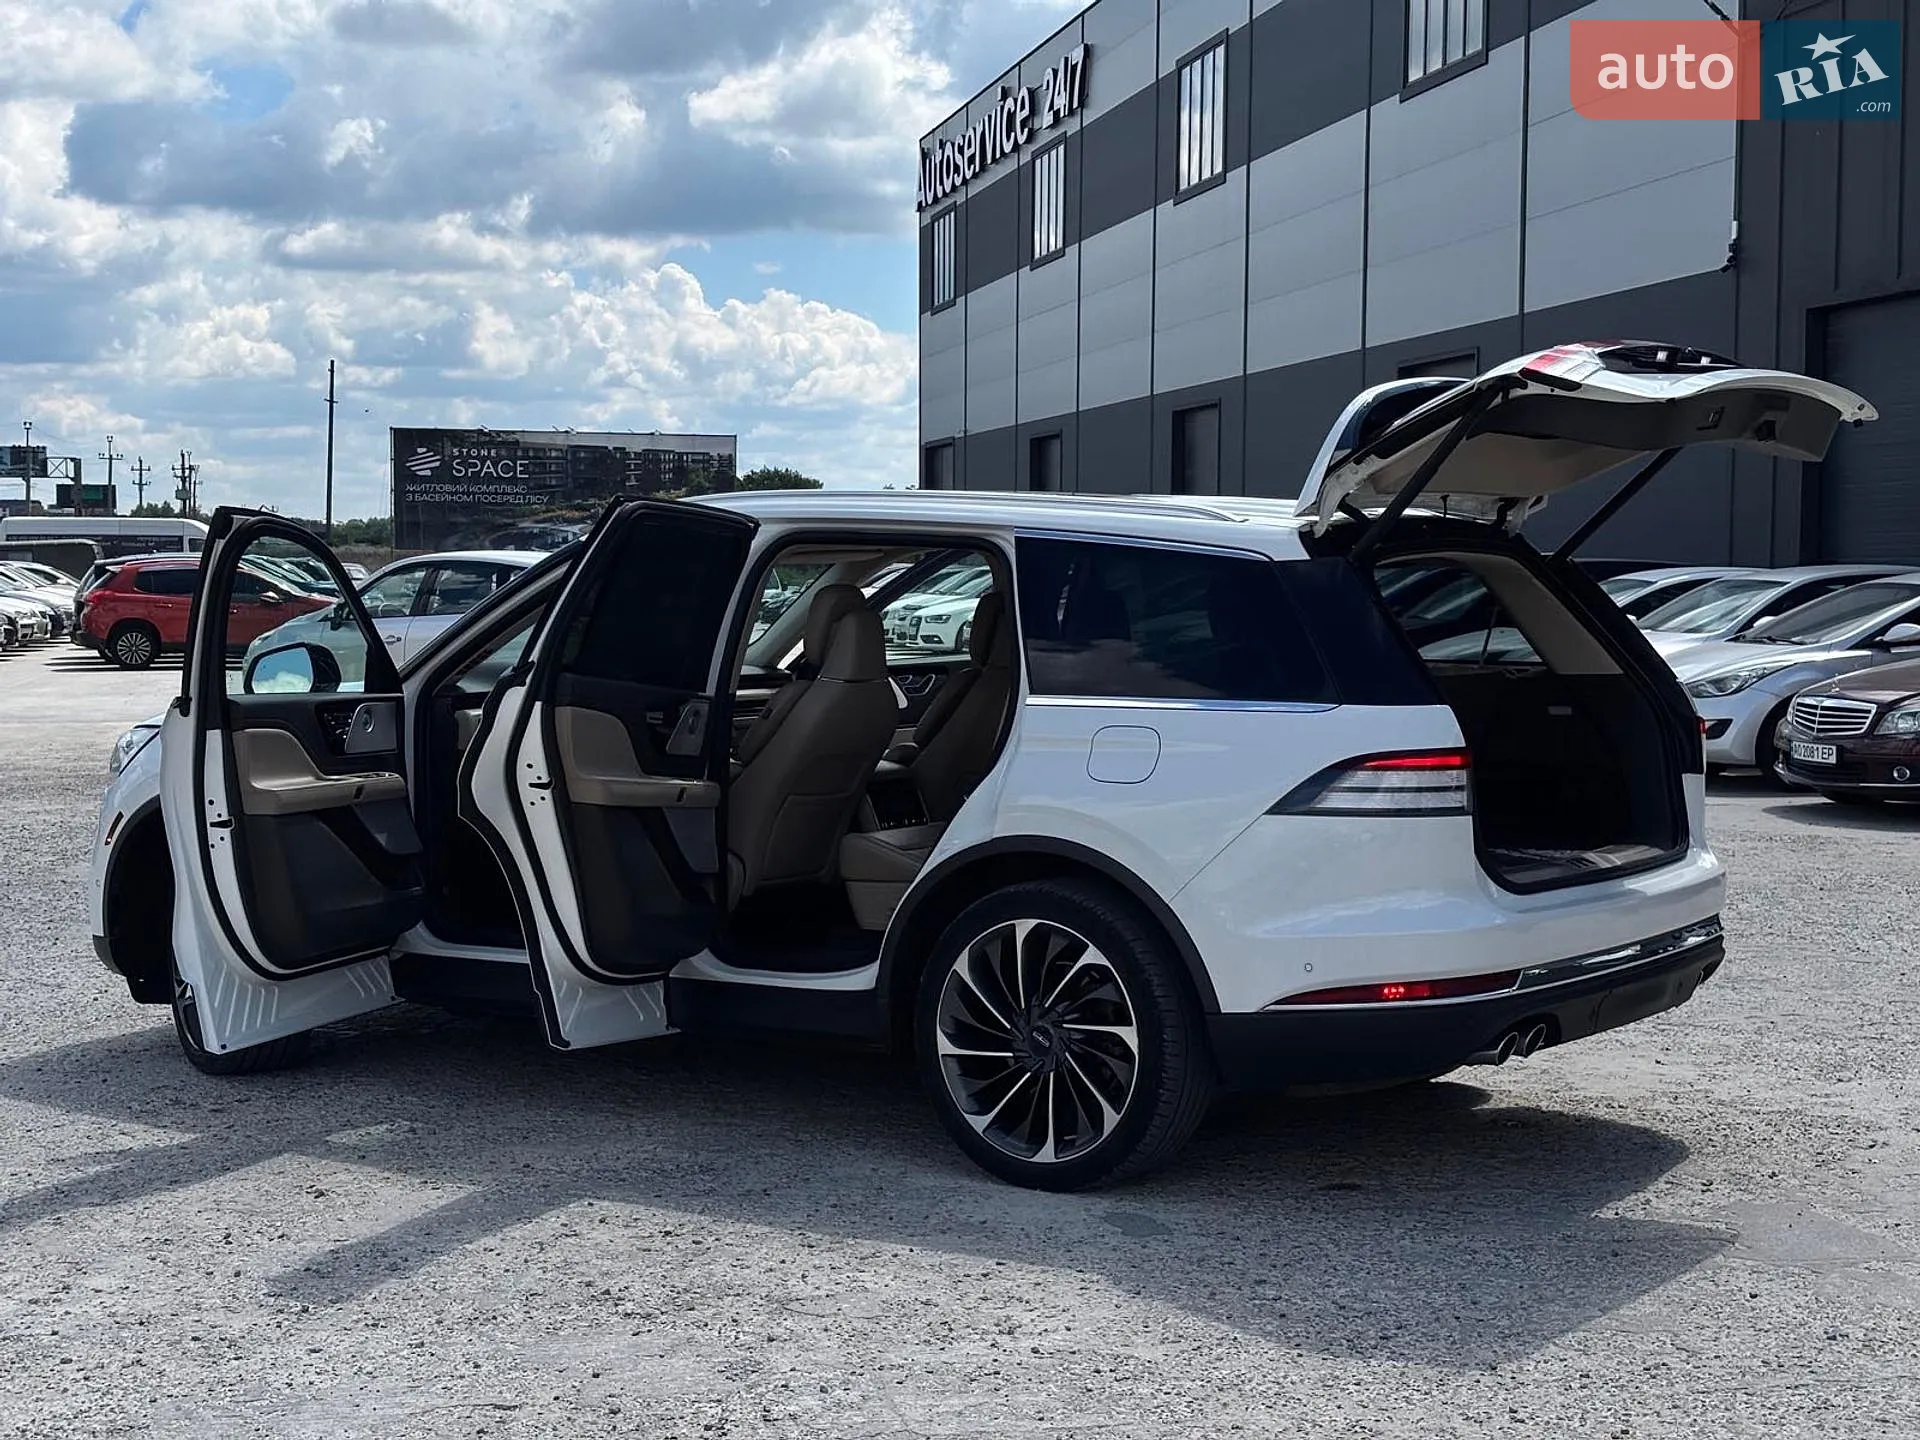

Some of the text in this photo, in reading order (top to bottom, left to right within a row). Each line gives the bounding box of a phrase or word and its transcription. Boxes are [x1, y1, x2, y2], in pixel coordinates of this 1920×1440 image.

[917, 43, 1086, 207] Autoservice 24/7
[452, 448, 498, 457] STONE
[452, 459, 530, 478] SPACE
[405, 483, 528, 494] ЖИТЛОВИЙ КОМПЛЕКС
[415, 493, 473, 502] БАСЕЙНОМ
[1821, 747, 1833, 760] EP
